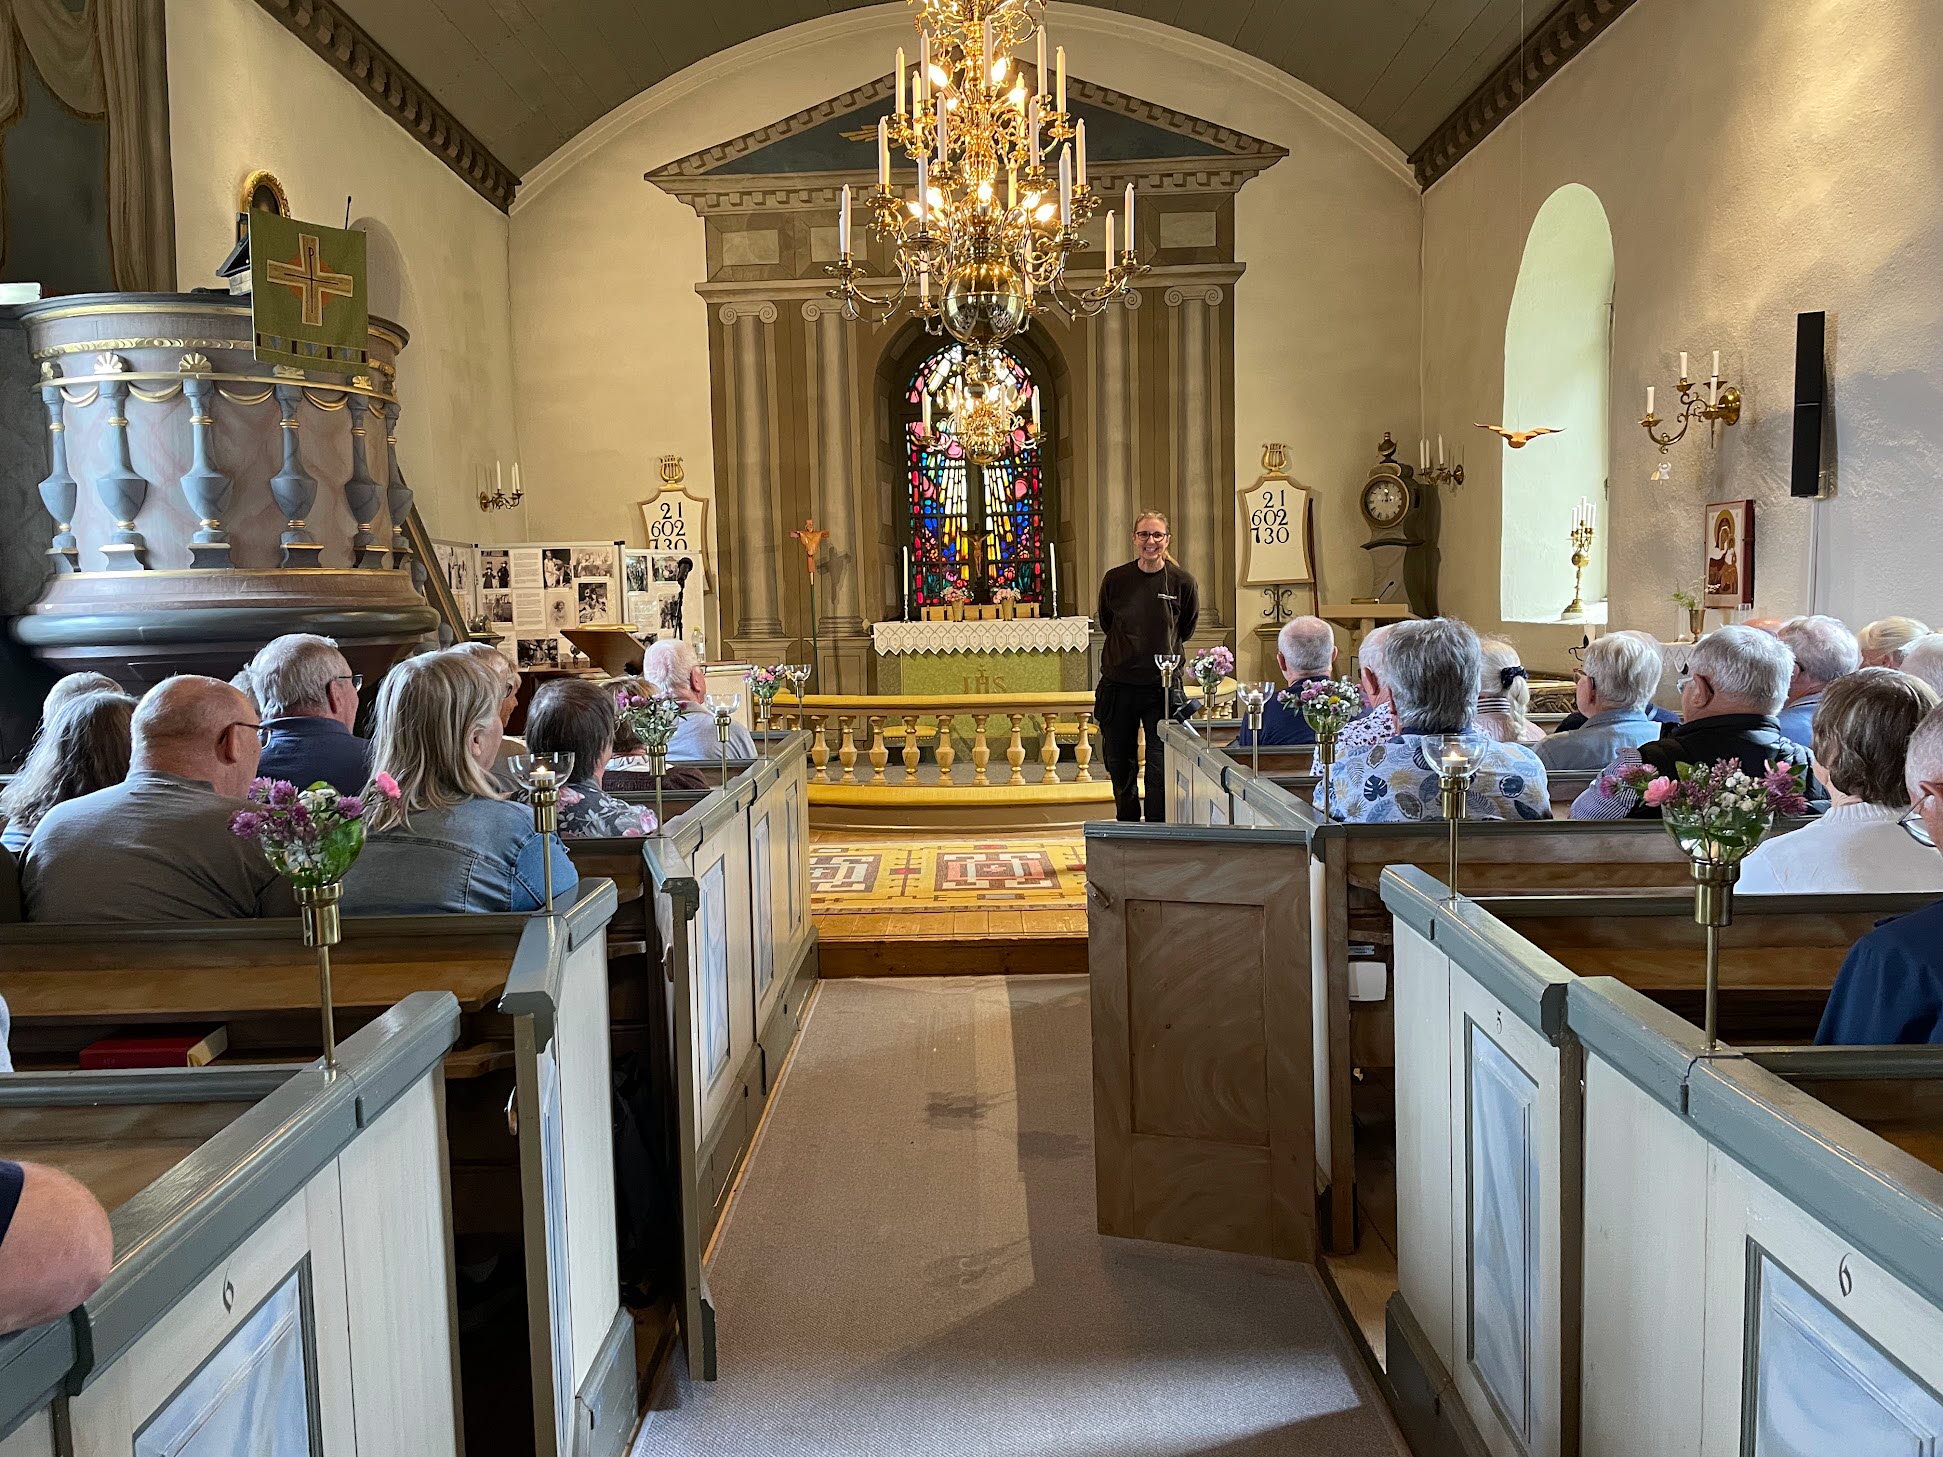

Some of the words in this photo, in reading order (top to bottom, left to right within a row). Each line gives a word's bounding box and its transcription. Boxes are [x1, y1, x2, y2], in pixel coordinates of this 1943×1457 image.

[1262, 489, 1285, 508] 21
[660, 501, 682, 520] 21
[1251, 508, 1289, 527] 602
[651, 520, 686, 538] 602
[1250, 527, 1290, 545] 730
[963, 674, 1008, 695] IHS
[1496, 1009, 1503, 1035] 5
[1838, 1251, 1853, 1298] 6
[222, 1264, 235, 1314] 6
